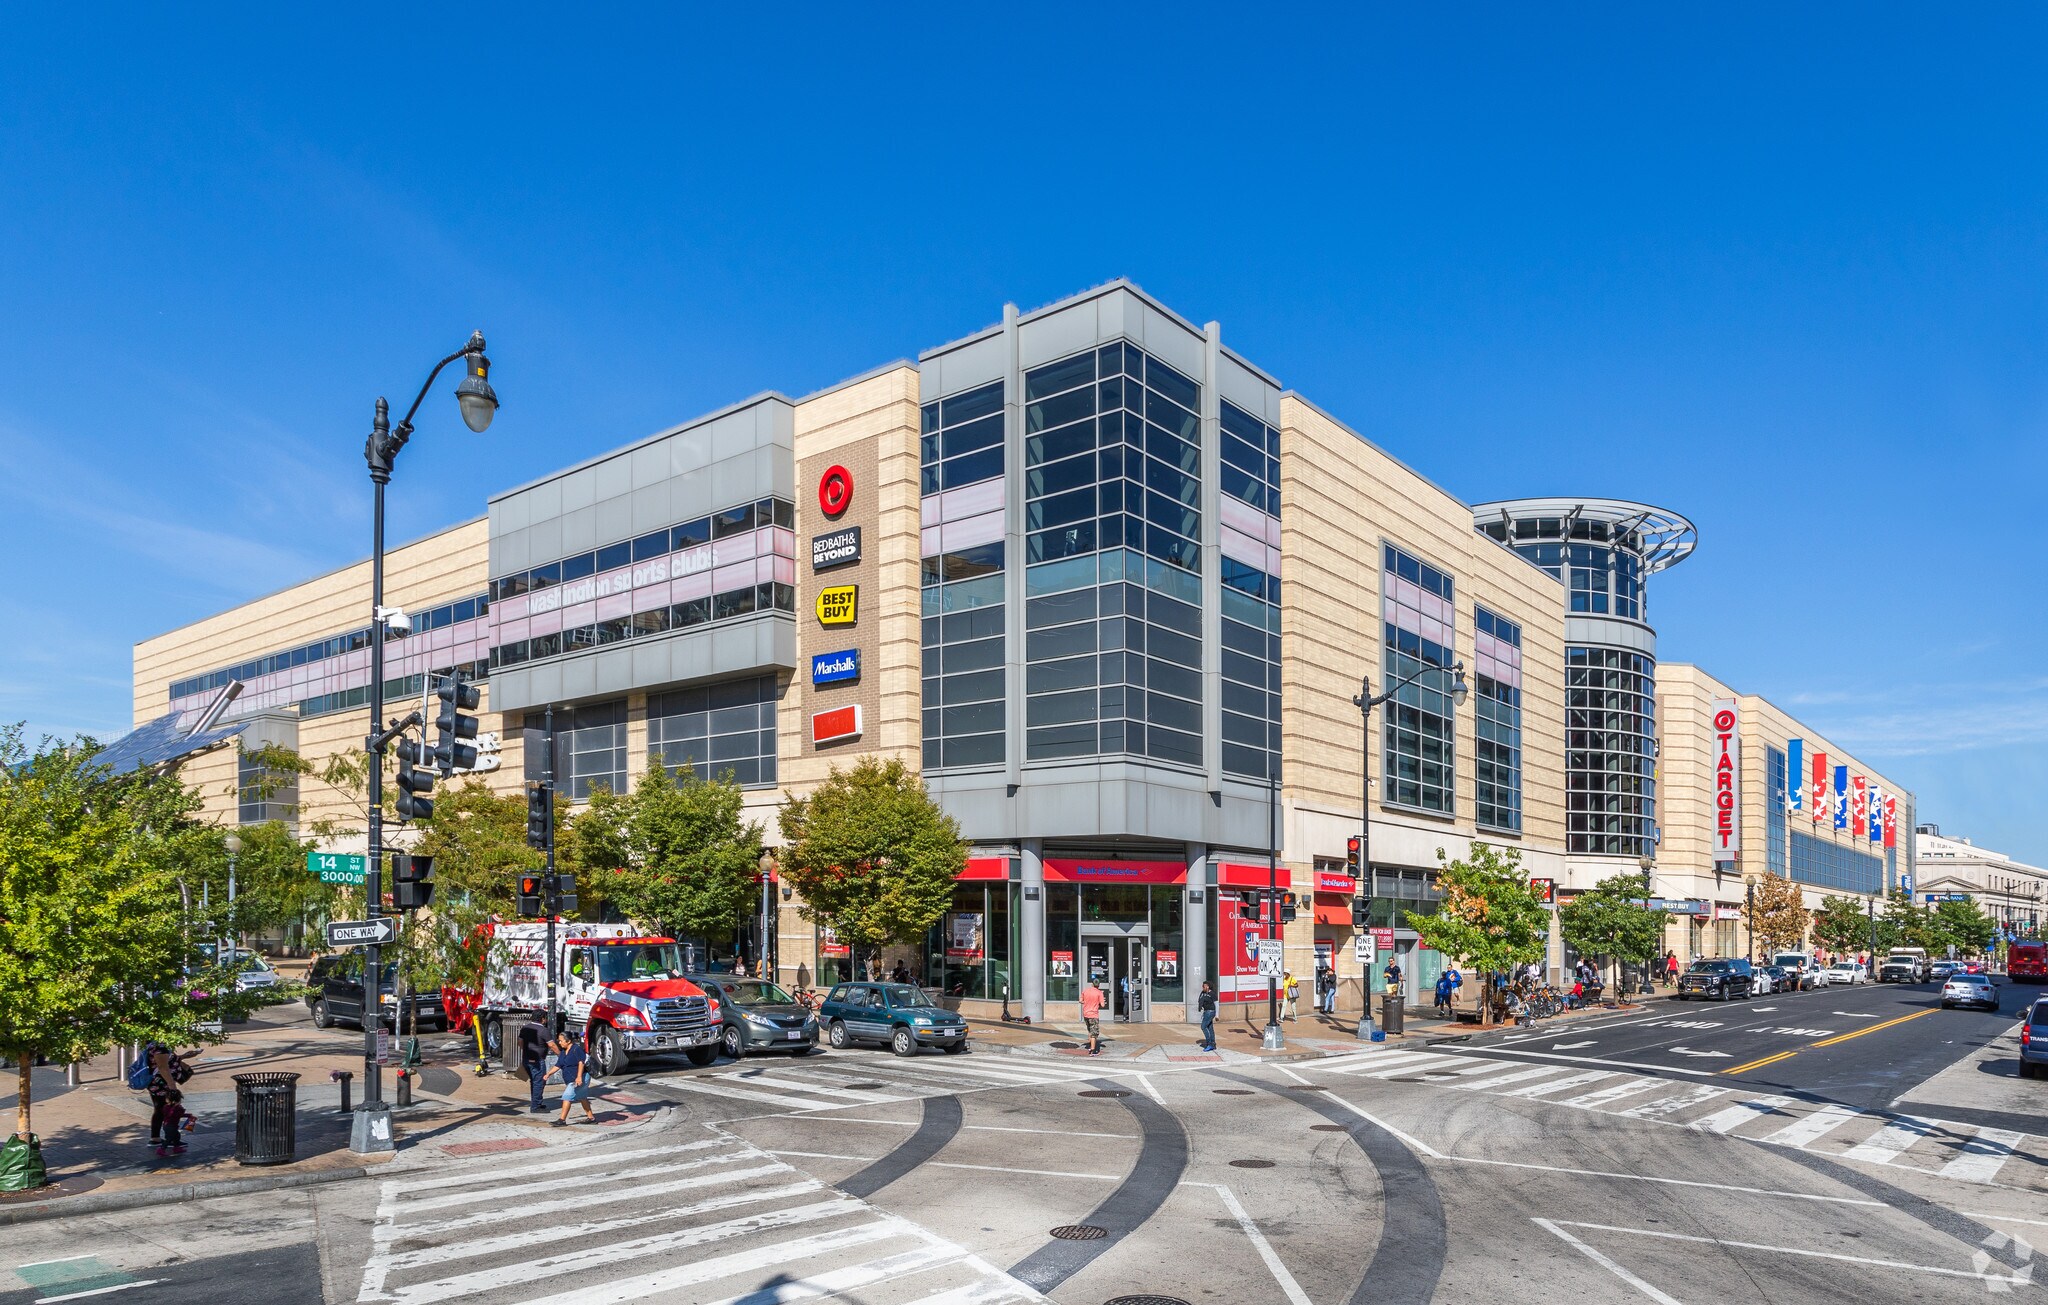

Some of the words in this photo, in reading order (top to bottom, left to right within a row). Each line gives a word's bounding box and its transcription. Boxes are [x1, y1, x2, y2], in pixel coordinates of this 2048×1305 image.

[813, 540, 828, 554] BED
[828, 533, 848, 550] BATH
[848, 532, 856, 545] &
[813, 545, 857, 564] BEYOND
[525, 576, 610, 615] washington
[613, 561, 667, 597] sports
[671, 546, 719, 578] clubs
[822, 592, 853, 606] BEST
[823, 605, 850, 618] BUY
[813, 656, 855, 676] Marshalls
[1716, 733, 1733, 848] TARGET
[318, 855, 337, 870] 14
[321, 871, 353, 881] 3000
[1077, 866, 1097, 875] Bank
[1098, 866, 1105, 875] of
[1106, 867, 1138, 876] America
[336, 930, 357, 939] ONE
[360, 927, 377, 937] WAY
[1357, 937, 1371, 945] ONE
[1260, 960, 1268, 972] OK
[1745, 1026, 1836, 1037] ONLY
